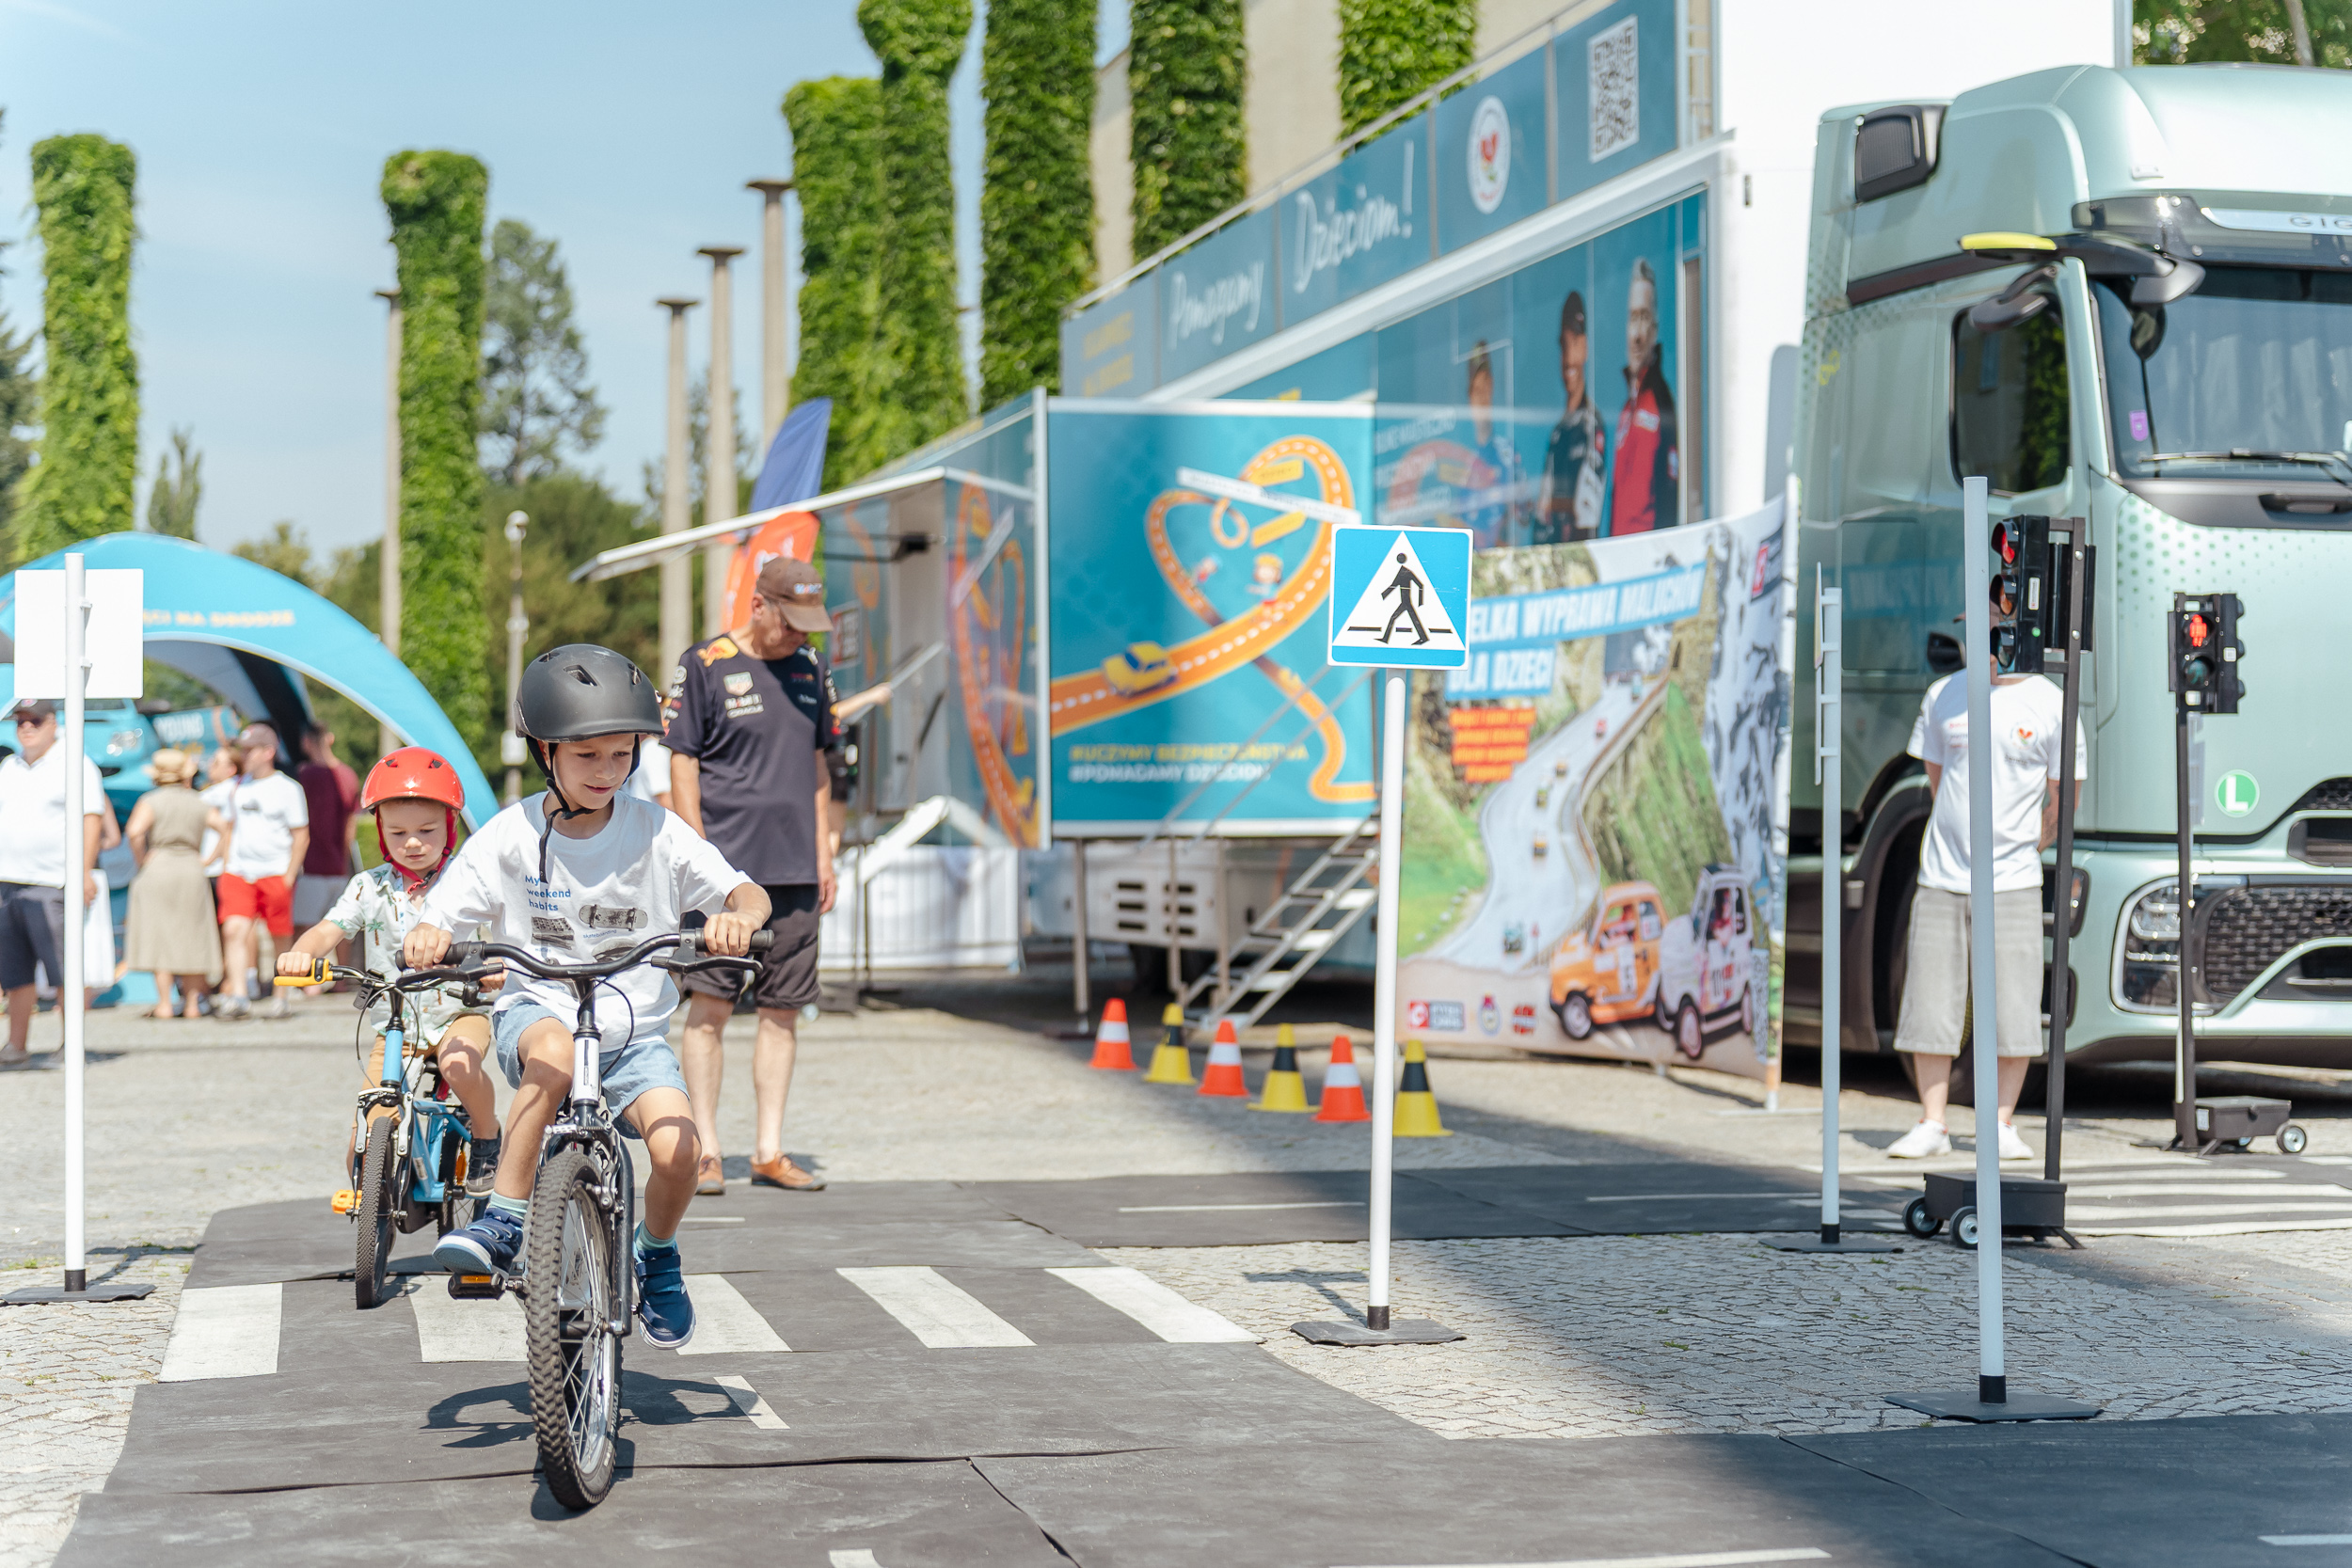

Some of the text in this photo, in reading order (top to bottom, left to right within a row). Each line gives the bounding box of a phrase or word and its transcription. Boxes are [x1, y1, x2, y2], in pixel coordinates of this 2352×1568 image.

[1293, 139, 1414, 293] Dzieciom!
[1470, 600, 1518, 643] ELKA
[1522, 585, 1618, 638] WYPRAWA
[1491, 647, 1552, 690] DZIECI
[2226, 775, 2249, 811] L
[525, 875, 541, 886] My
[527, 889, 571, 897] weekend
[529, 899, 558, 911] habits
